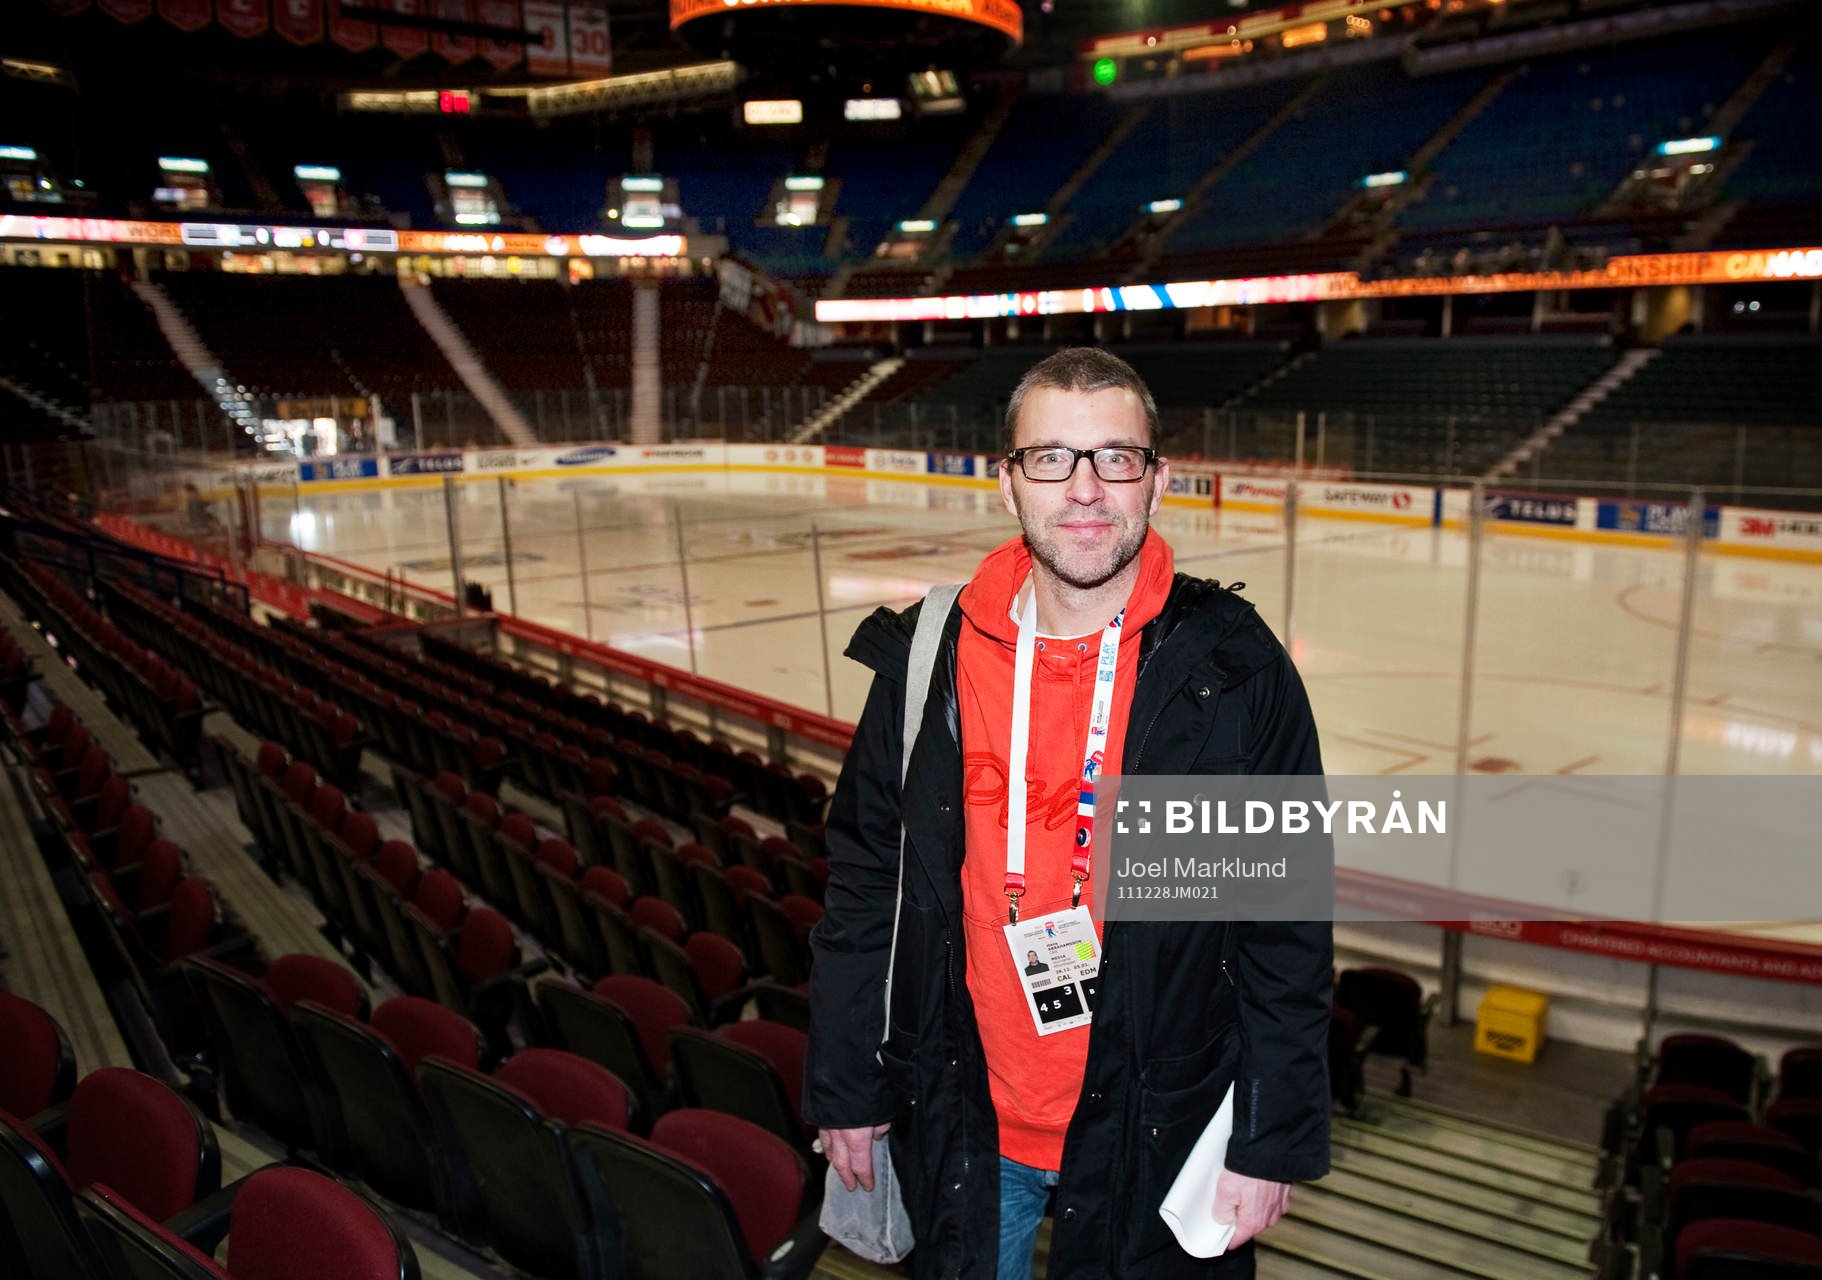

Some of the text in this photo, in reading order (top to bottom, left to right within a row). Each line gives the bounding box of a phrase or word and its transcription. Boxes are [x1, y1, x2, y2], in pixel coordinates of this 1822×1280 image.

[1510, 499, 1576, 519] TELUS
[1740, 518, 1775, 536] 3M
[1057, 967, 1097, 981] CAL EDM
[1063, 985, 1073, 995] 3
[1040, 999, 1062, 1012] 4 5
